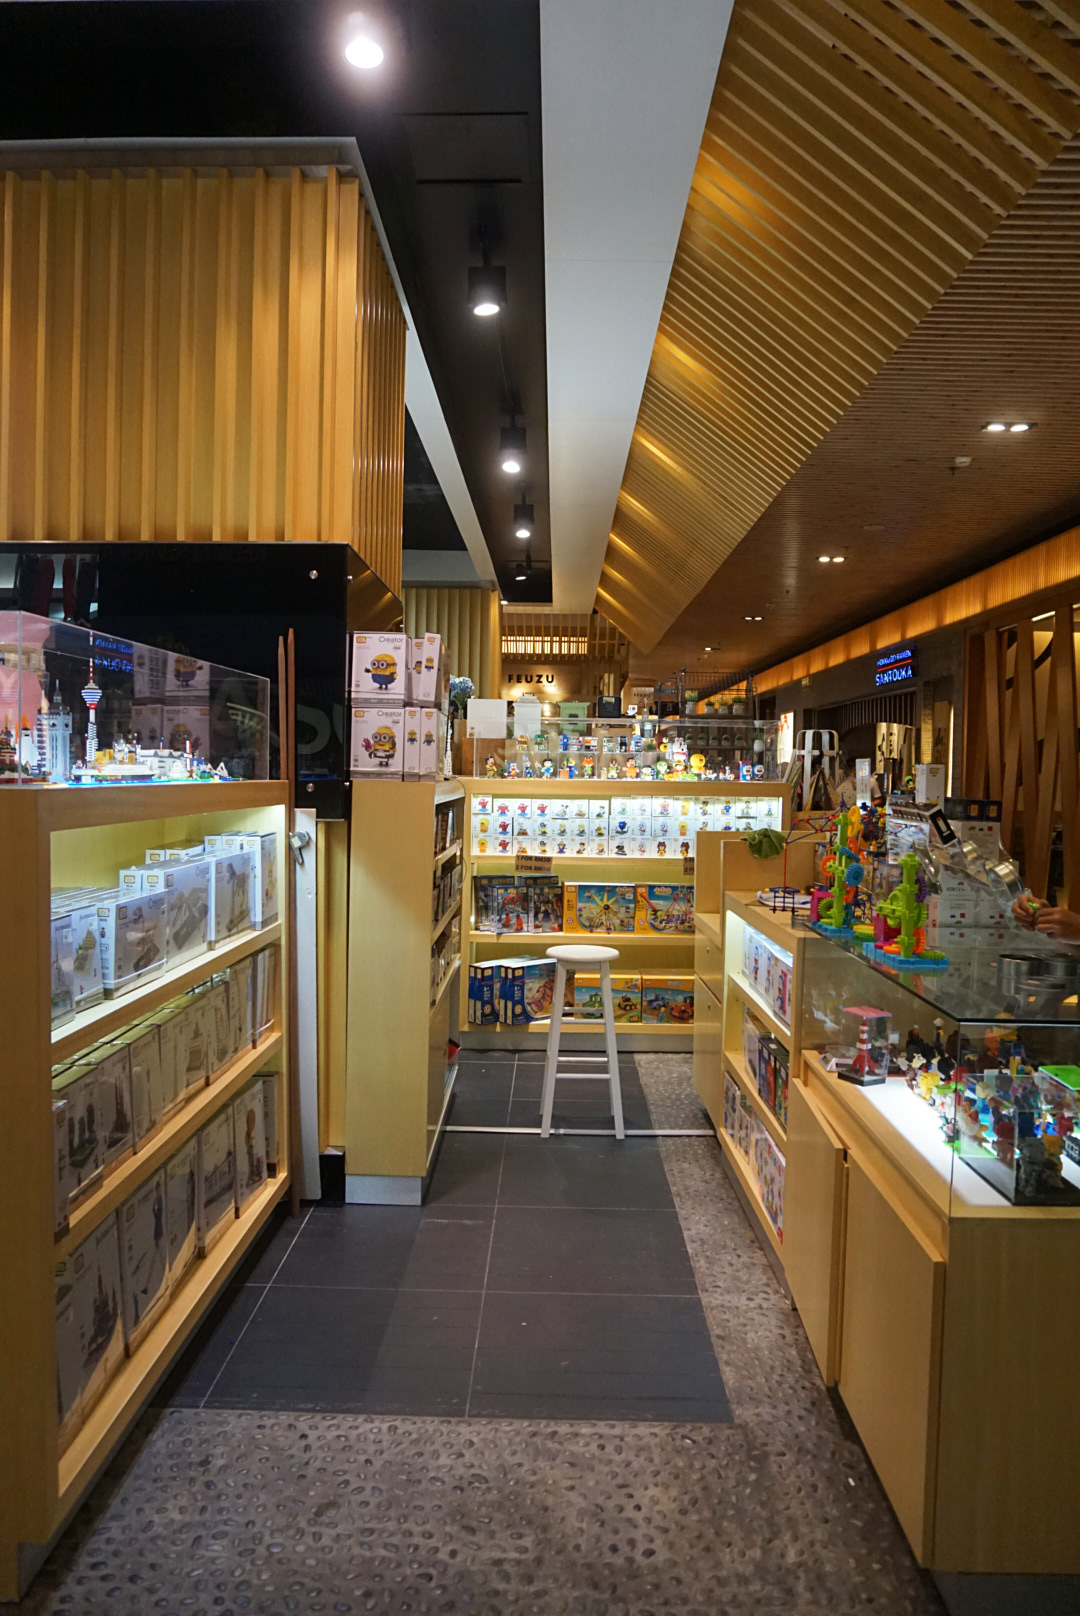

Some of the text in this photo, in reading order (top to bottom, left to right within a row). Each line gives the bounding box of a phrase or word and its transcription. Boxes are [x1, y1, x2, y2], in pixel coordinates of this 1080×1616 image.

[508, 674, 554, 684] FEUZU
[875, 665, 913, 686] SANTOUKA
[376, 709, 402, 718] Creator
